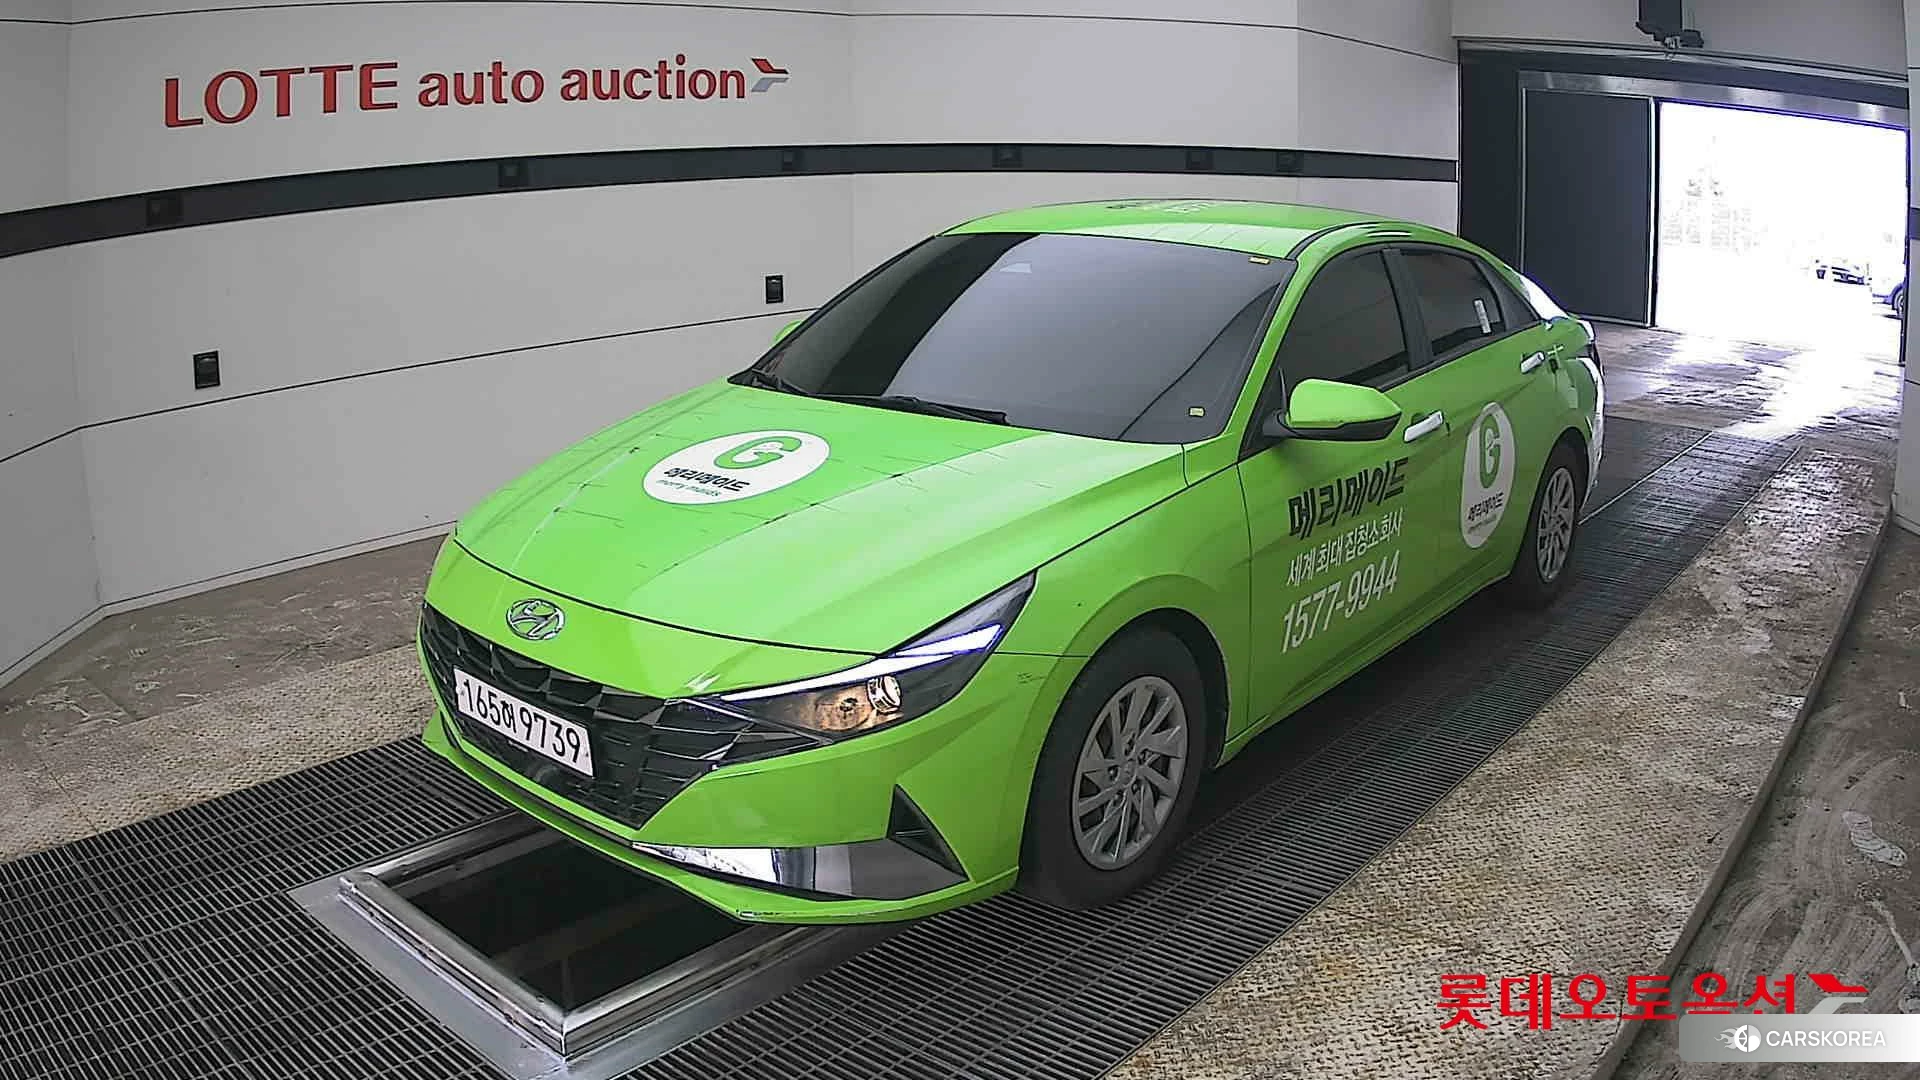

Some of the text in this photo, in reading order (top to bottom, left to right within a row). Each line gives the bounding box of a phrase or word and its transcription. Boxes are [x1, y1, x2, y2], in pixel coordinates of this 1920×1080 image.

[165, 54, 746, 128] LOTTE auto auction
[1287, 457, 1409, 540] 메리메이드
[1282, 549, 1400, 654] 1577-9944
